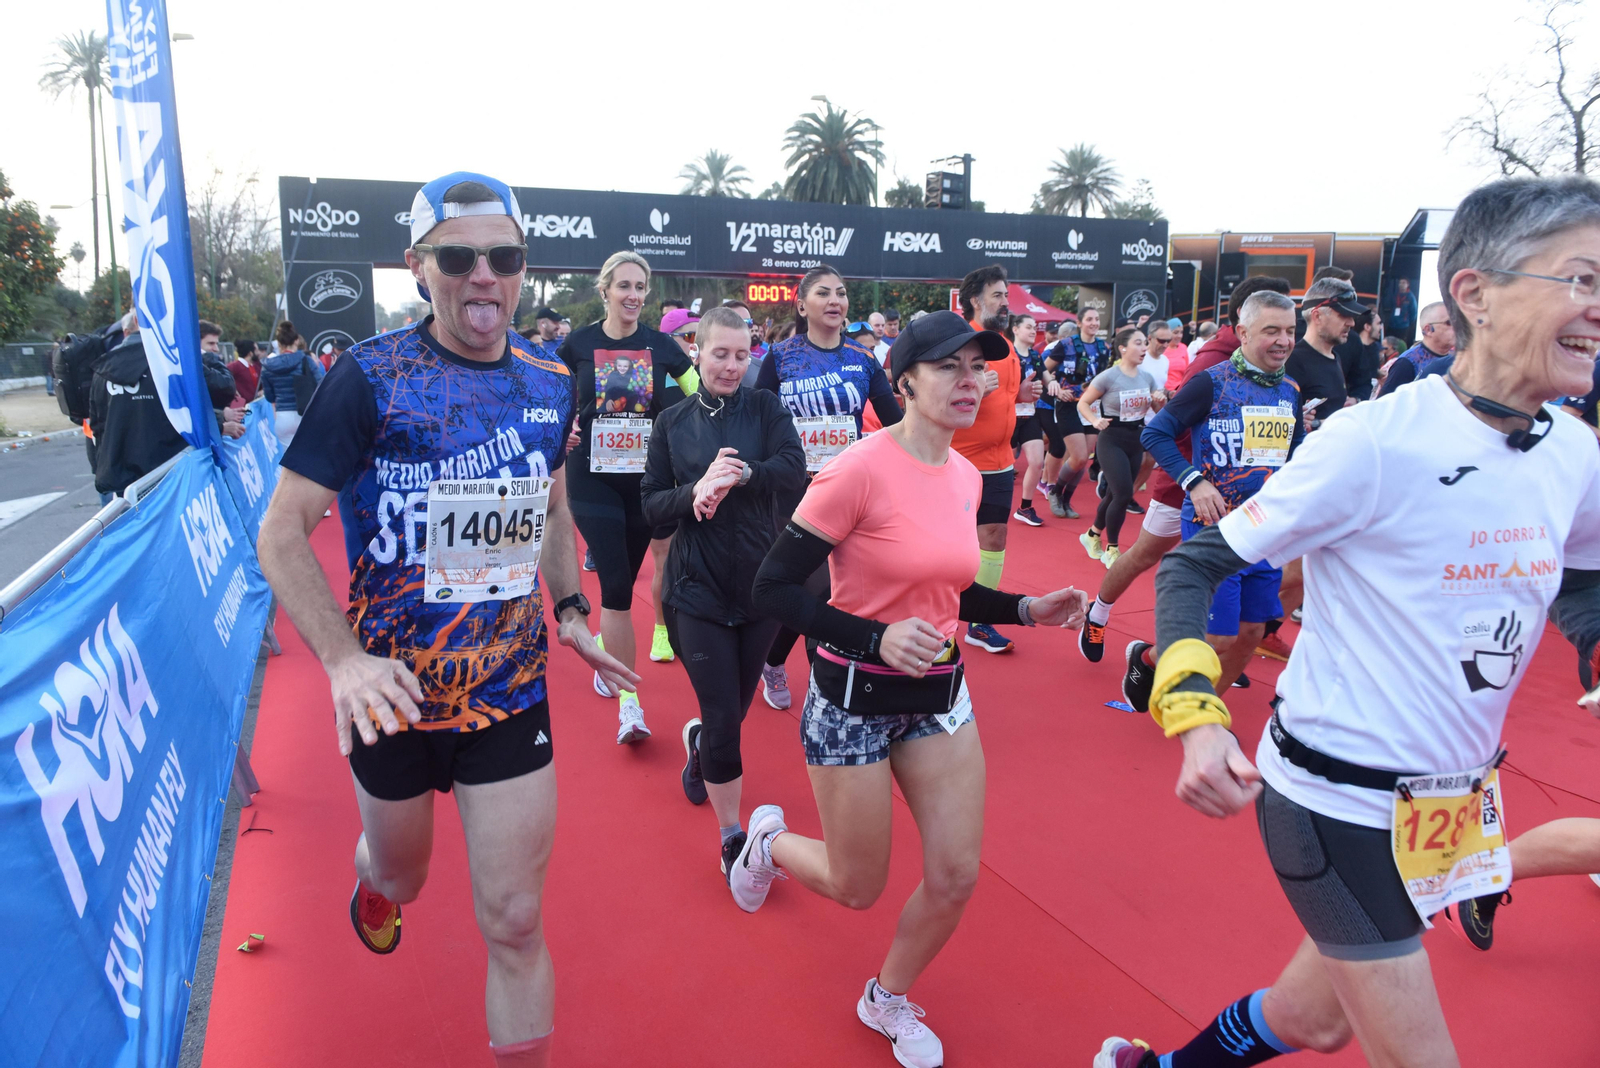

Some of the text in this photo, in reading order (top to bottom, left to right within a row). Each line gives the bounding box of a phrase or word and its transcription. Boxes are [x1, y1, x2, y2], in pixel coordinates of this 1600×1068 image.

[522, 213, 595, 239] HOKA
[750, 222, 836, 241] maratón
[883, 230, 943, 253] HOKA
[985, 239, 1028, 251] HYUNDAI
[665, 248, 686, 257] Partner
[762, 258, 822, 269] 28 enero 2024
[841, 365, 863, 373] HOKA
[796, 371, 844, 393] MARATÓN
[523, 407, 559, 424] HOKA
[1208, 418, 1240, 432] MEDIO
[800, 428, 849, 447] 14155
[1249, 420, 1289, 439] 12209
[597, 431, 642, 449] 13251
[374, 425, 525, 489] MEDIO MARATÓN
[437, 479, 540, 497] MEDIO MARATÓN SEVILLA
[440, 507, 534, 548] 14045
[1468, 525, 1547, 549] JO CORRO X
[179, 482, 234, 599] HOKA
[1463, 620, 1491, 635] caliu
[14, 601, 159, 919] HOKA
[1408, 778, 1434, 792] MEDIO
[104, 738, 187, 1020] FLY HUMAN FLY
